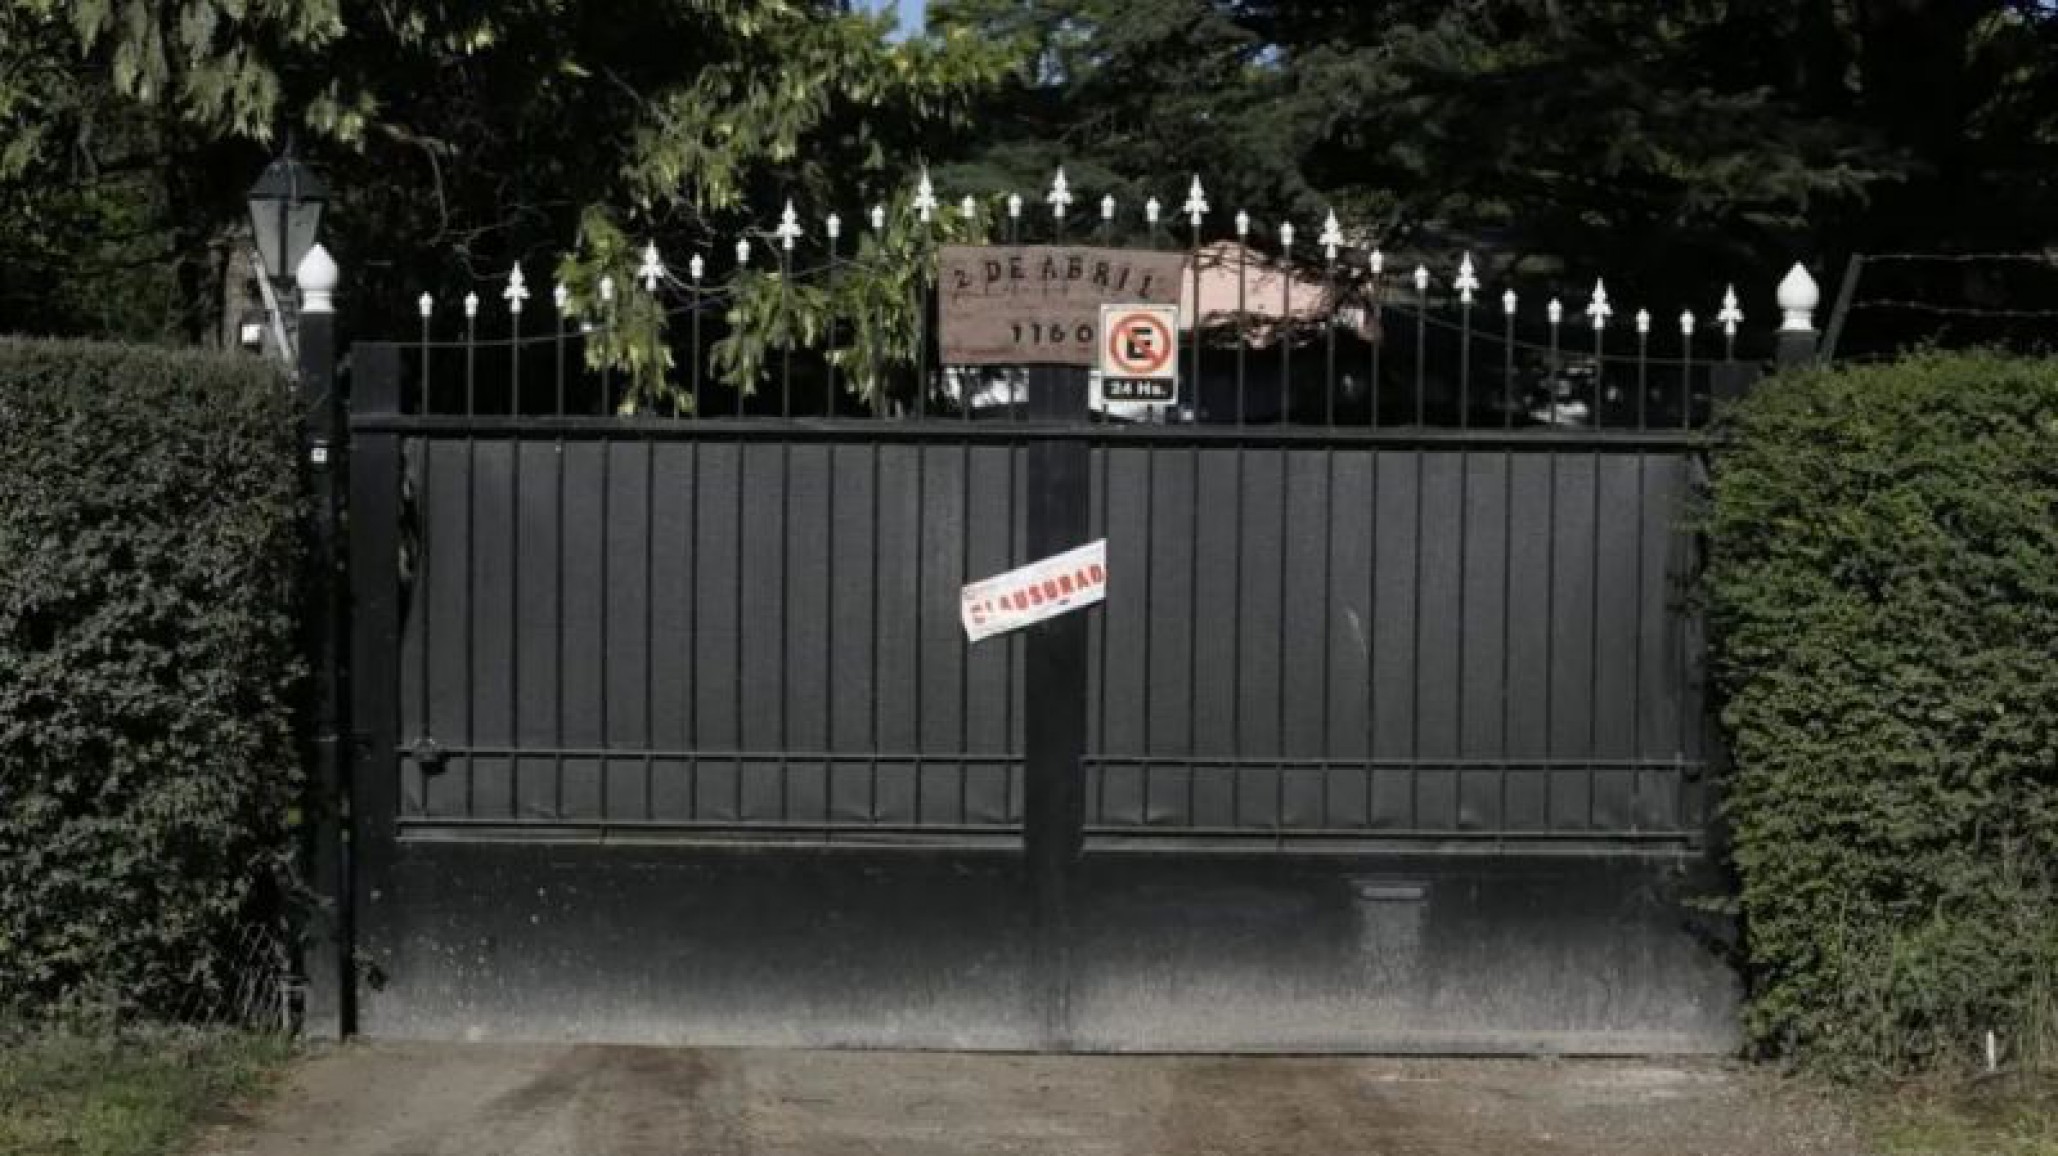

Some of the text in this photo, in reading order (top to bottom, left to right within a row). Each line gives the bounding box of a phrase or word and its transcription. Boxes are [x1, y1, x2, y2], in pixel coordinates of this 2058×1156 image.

[953, 269, 971, 288] 2
[984, 256, 1026, 284] DE
[1010, 322, 1095, 345] 1160
[1110, 380, 1132, 395] 24
